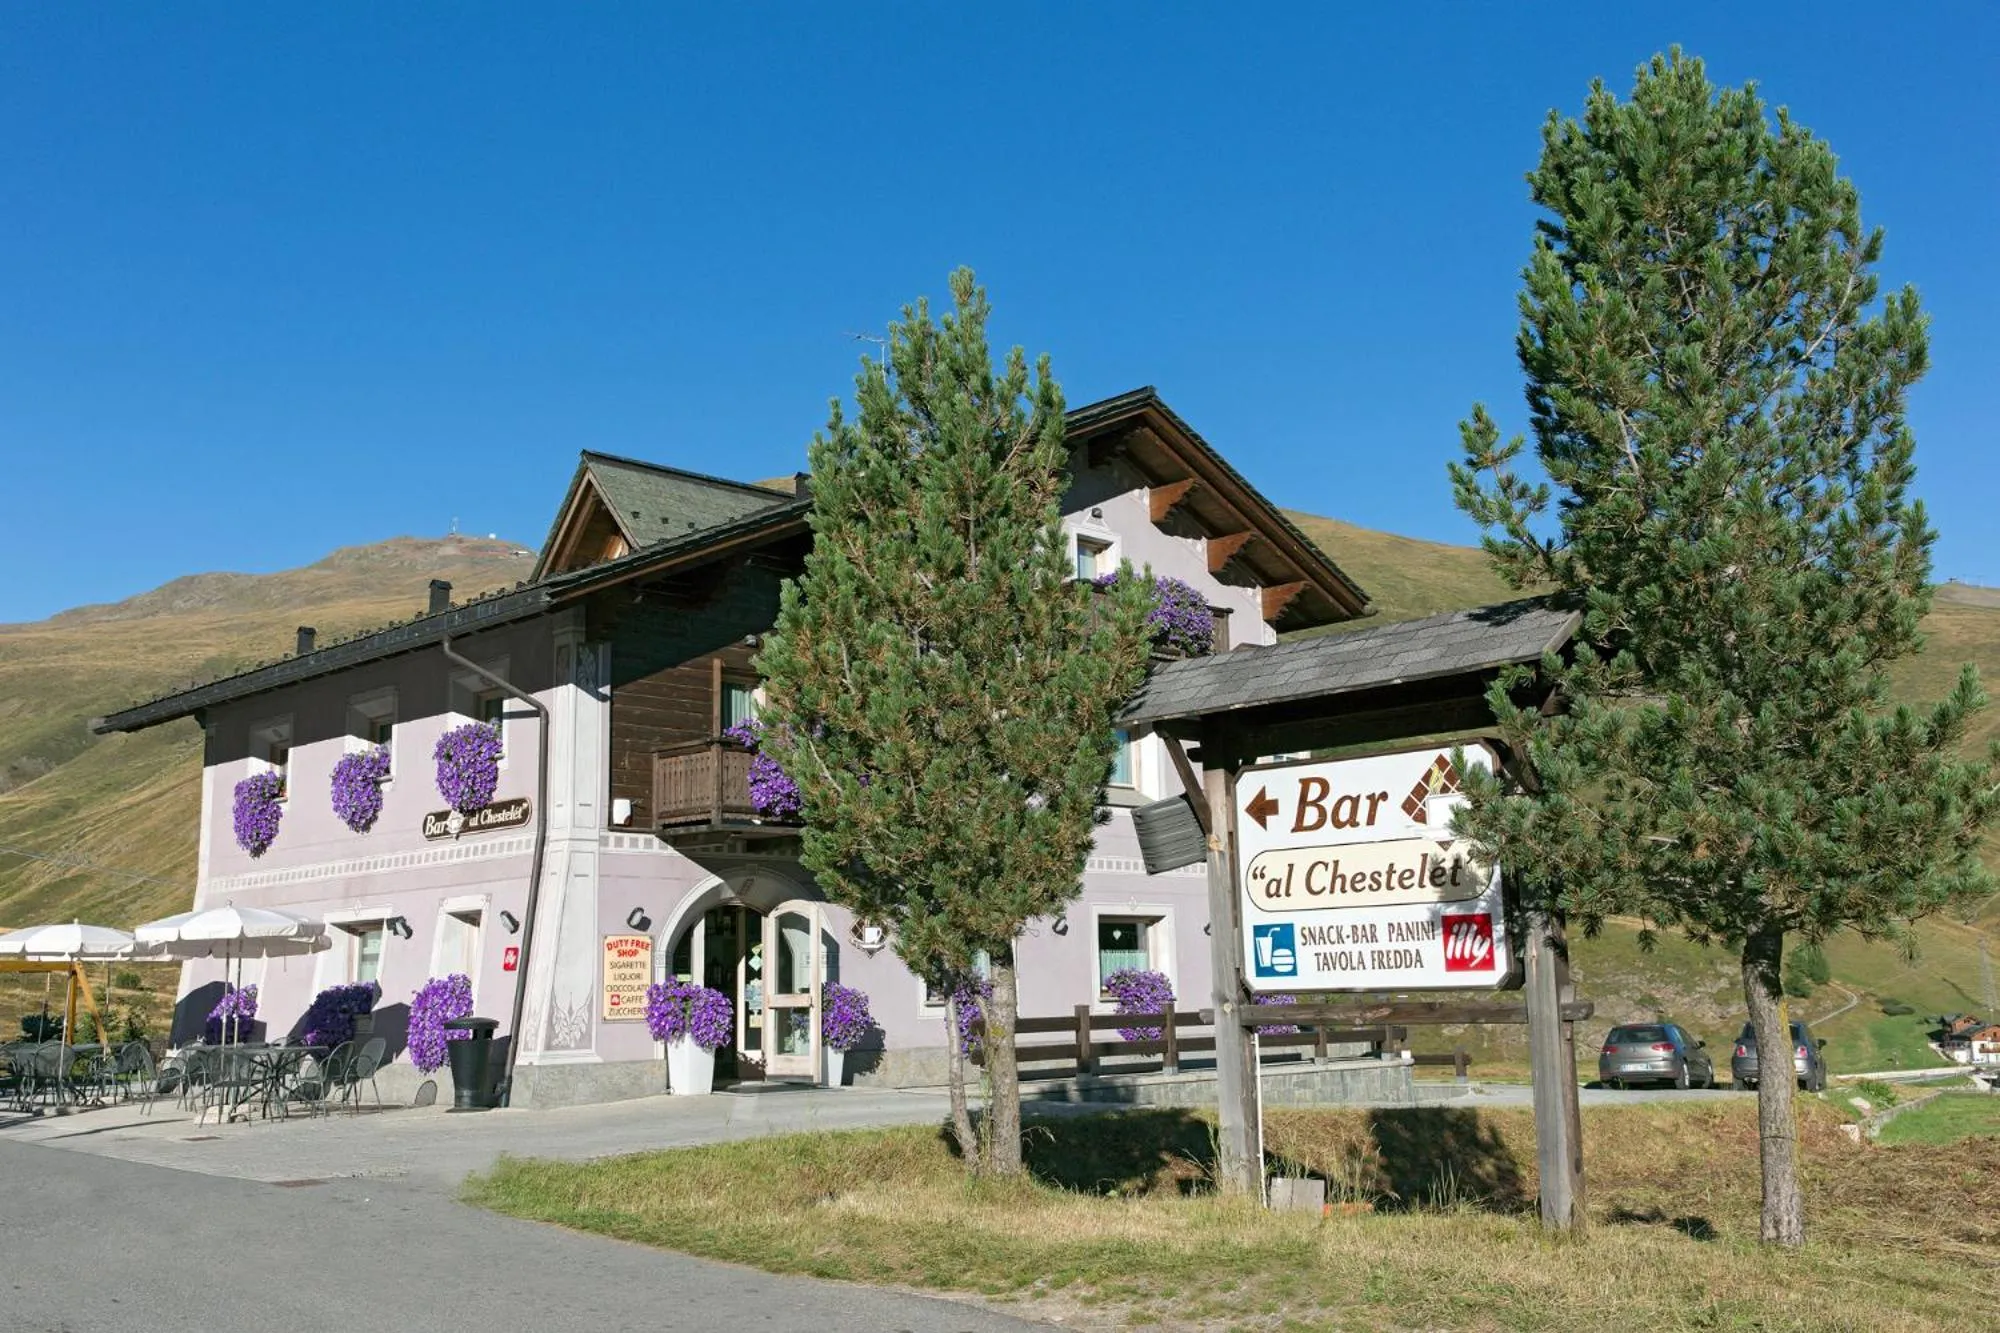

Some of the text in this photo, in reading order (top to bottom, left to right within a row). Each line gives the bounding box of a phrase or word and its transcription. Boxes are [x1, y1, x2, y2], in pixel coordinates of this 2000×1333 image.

[1290, 776, 1389, 833] Bar
[425, 815, 448, 836] Bar
[1300, 920, 1436, 946] SNACK-BAR PANINI
[606, 939, 651, 951] DUTY FREE
[617, 949, 640, 958] SHOP
[1446, 922, 1491, 968] illy
[609, 961, 647, 970] SIGARETTE
[1314, 949, 1424, 972] TAVOLA FREDDA
[613, 972, 644, 981] LIQUORI
